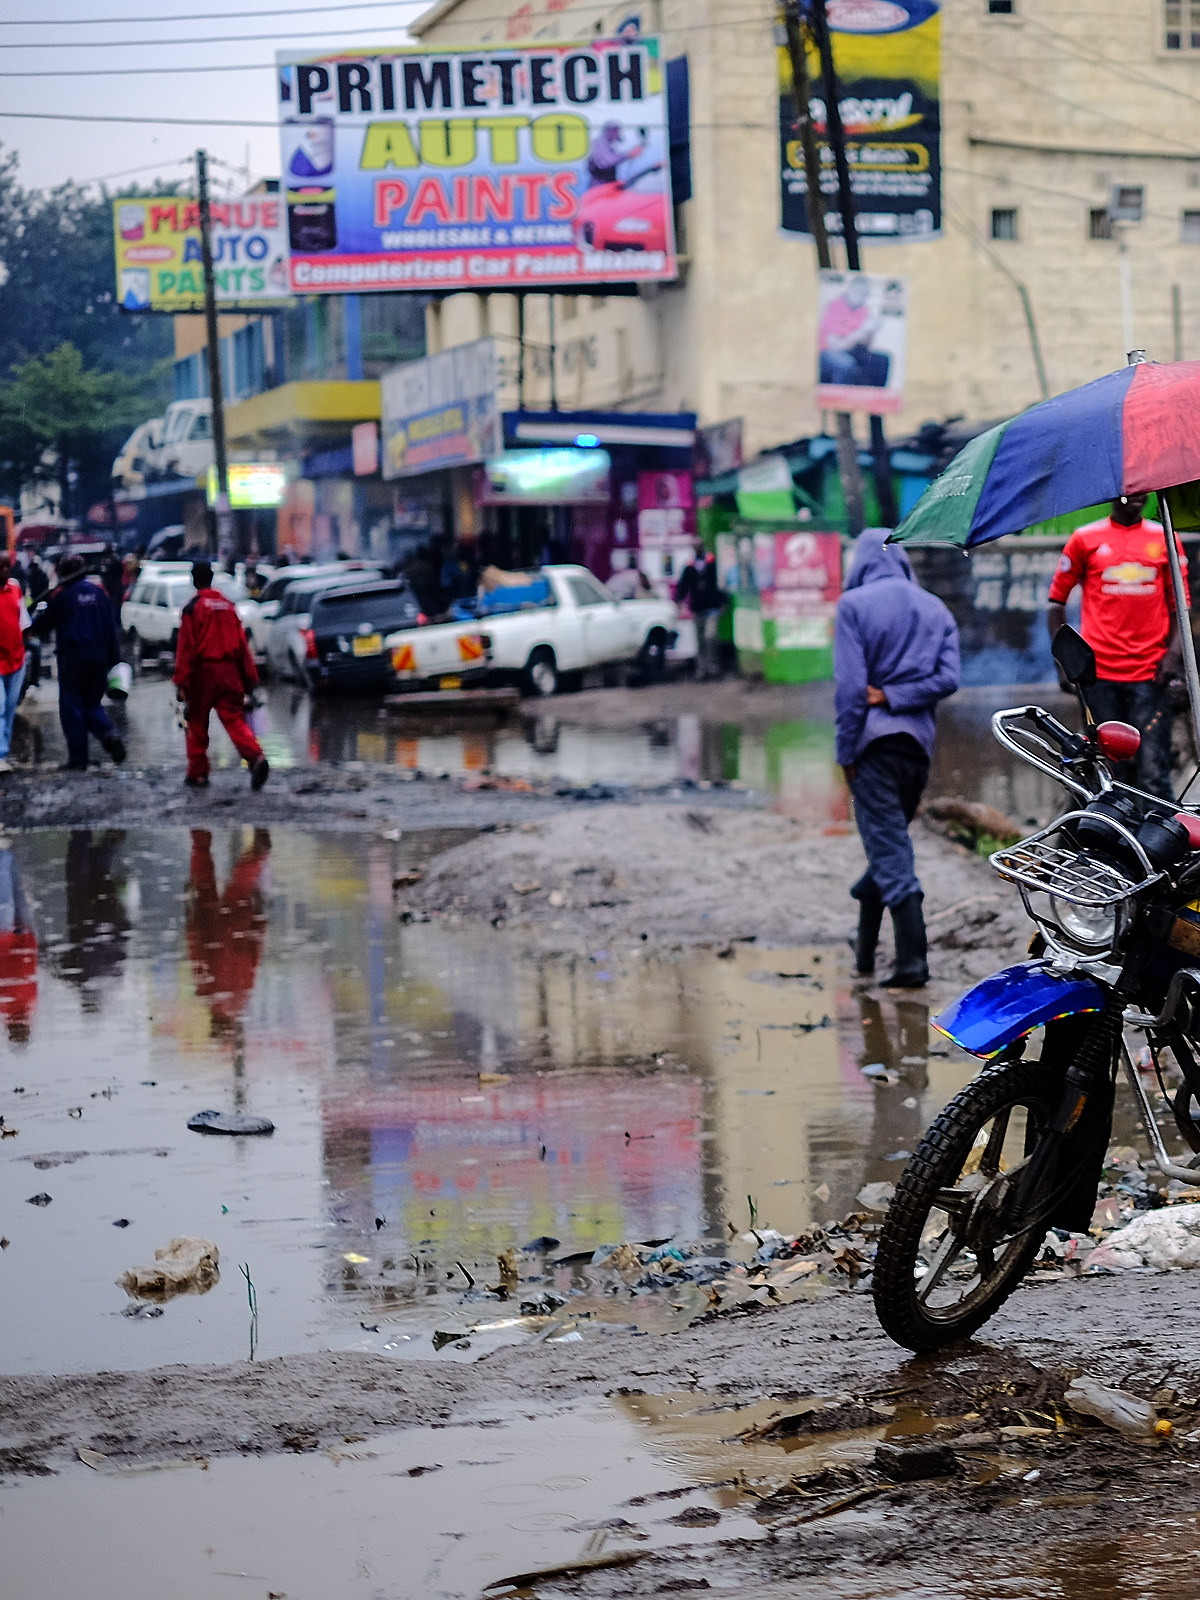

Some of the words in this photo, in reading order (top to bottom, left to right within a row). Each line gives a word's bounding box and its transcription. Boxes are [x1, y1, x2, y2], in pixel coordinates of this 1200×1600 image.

[297, 53, 643, 114] PRIMETECH
[360, 114, 589, 169] AUTO
[374, 171, 579, 227] PAINTS
[382, 229, 490, 249] WHOLESALE
[295, 256, 464, 285] Computerized
[468, 255, 510, 277] Car
[515, 253, 578, 276] Paint
[584, 249, 665, 276] Mixing
